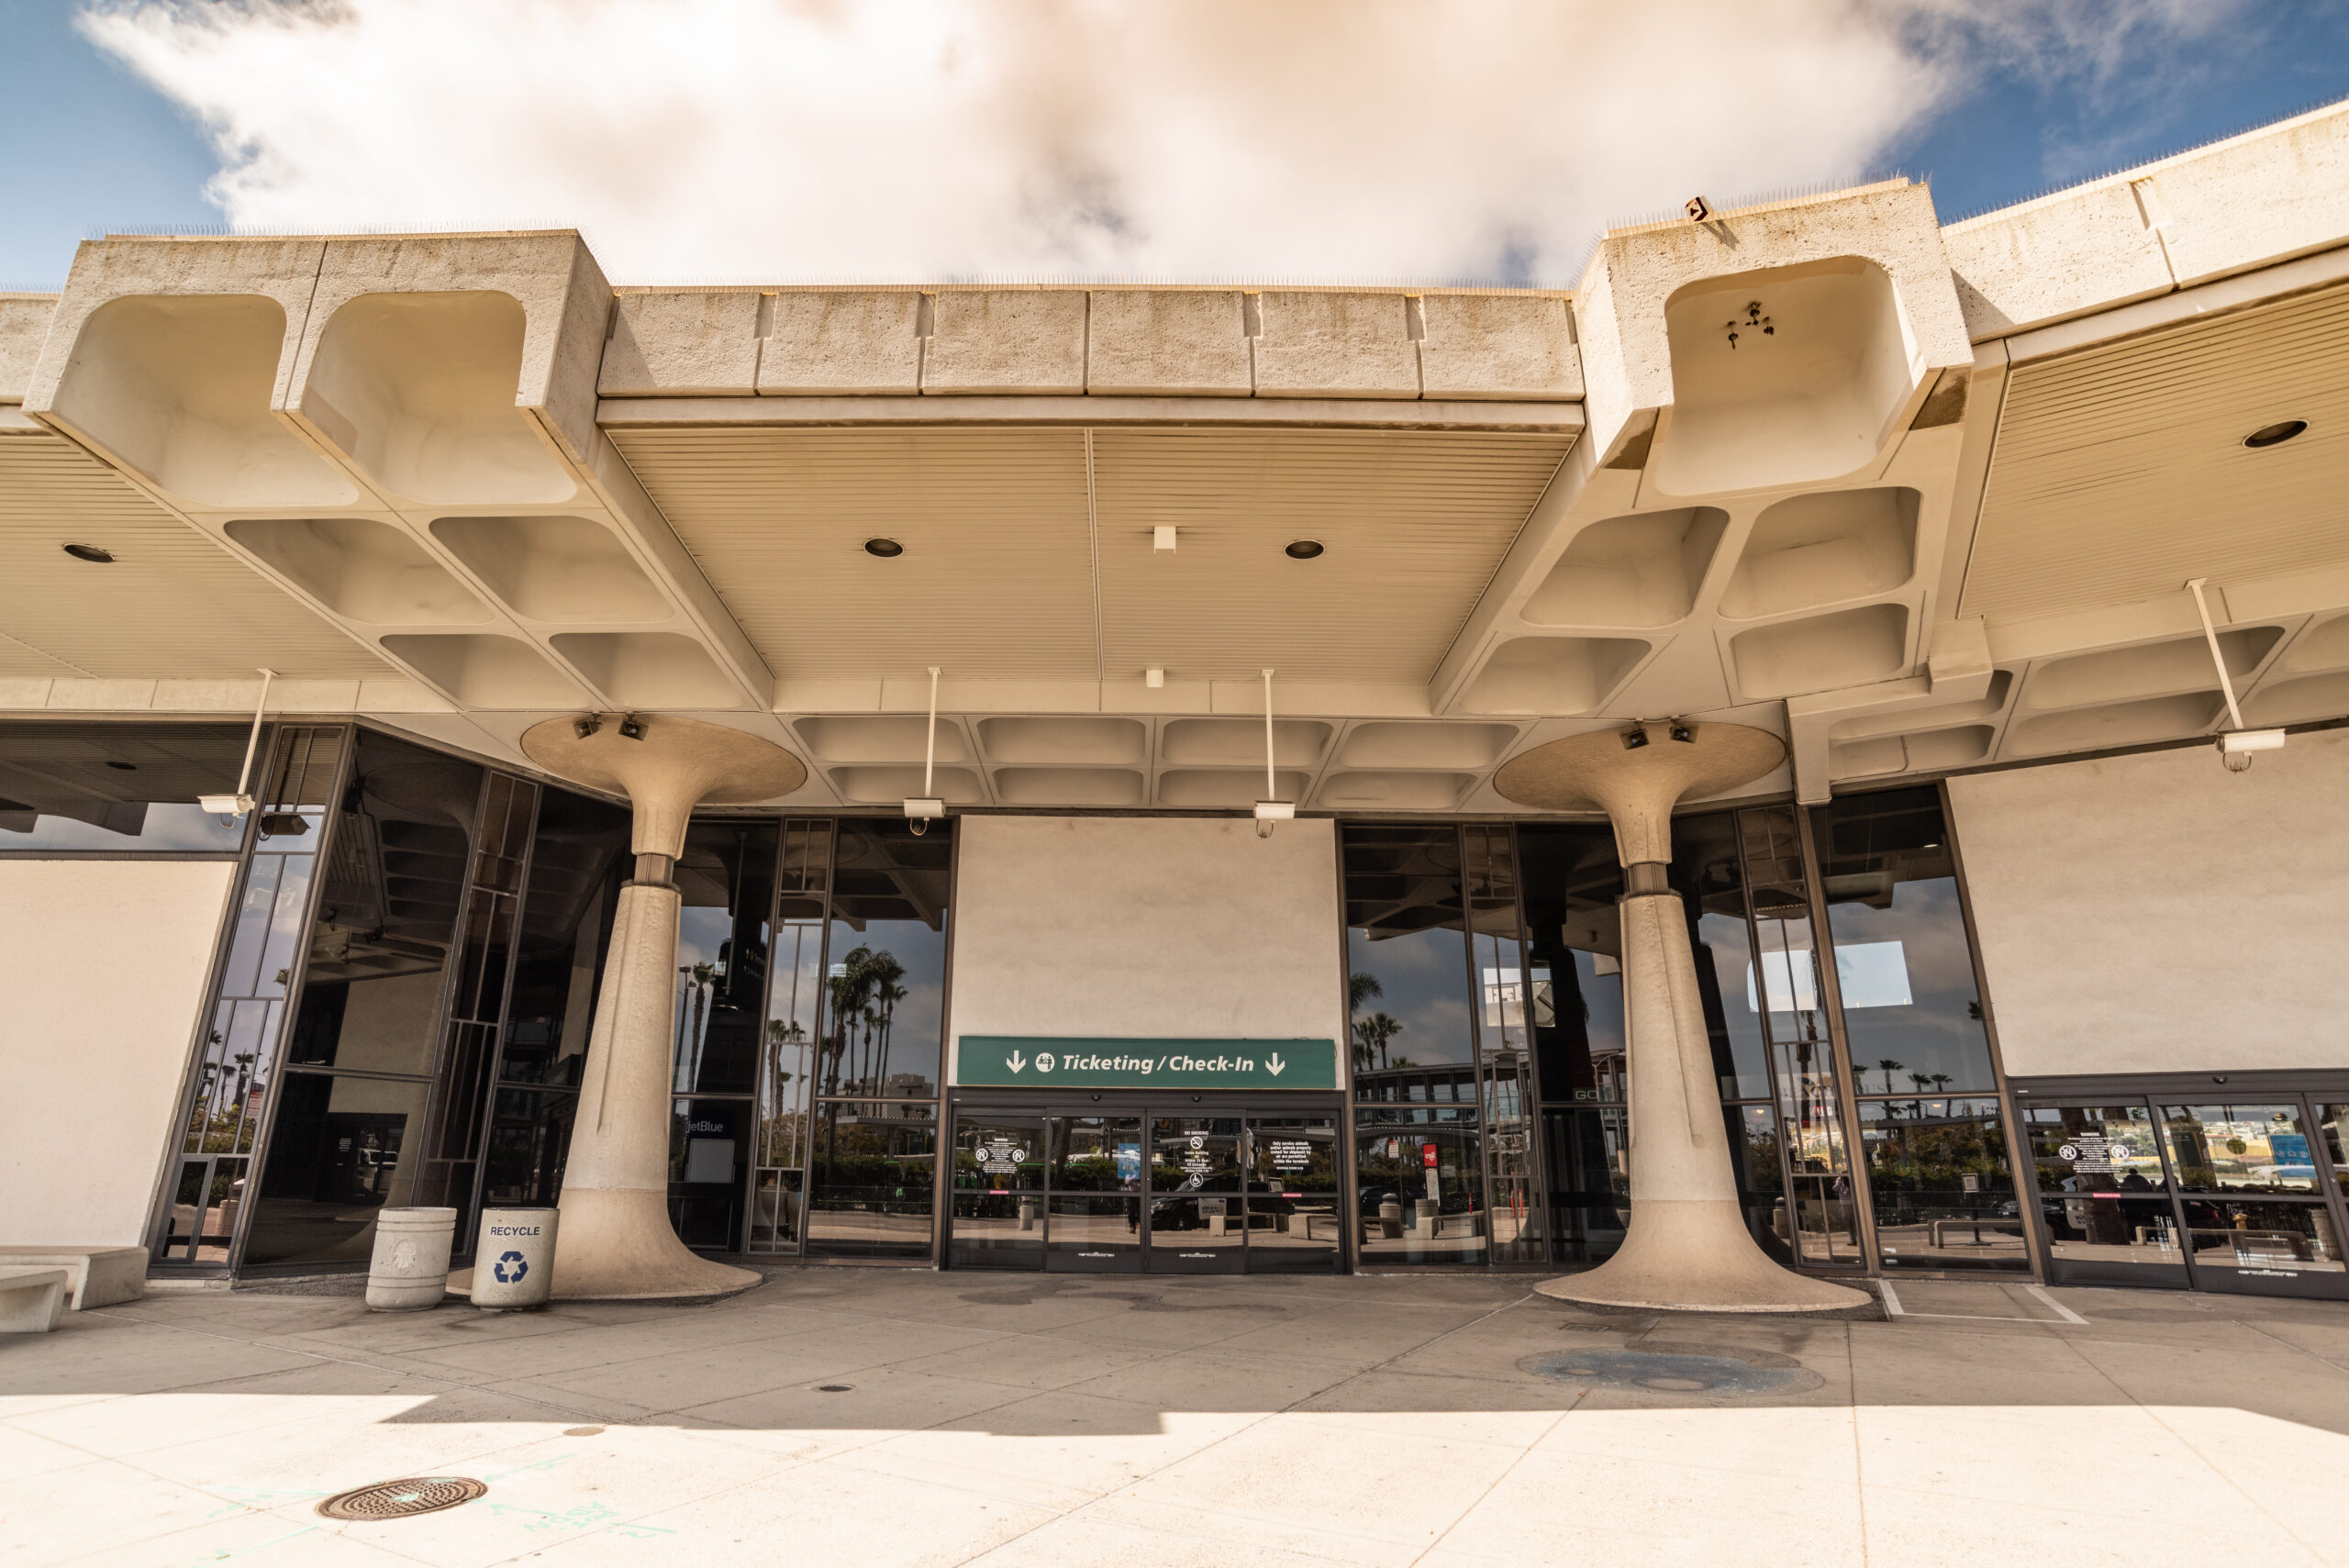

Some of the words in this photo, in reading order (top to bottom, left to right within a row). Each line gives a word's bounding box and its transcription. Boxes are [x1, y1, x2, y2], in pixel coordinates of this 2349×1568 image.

[1063, 1054, 1153, 1074] Ticketing
[1156, 1055, 1167, 1071] /
[1169, 1055, 1254, 1072] Check-In
[685, 1120, 723, 1134] jetBlue
[490, 1226, 541, 1236] RECYCLE
